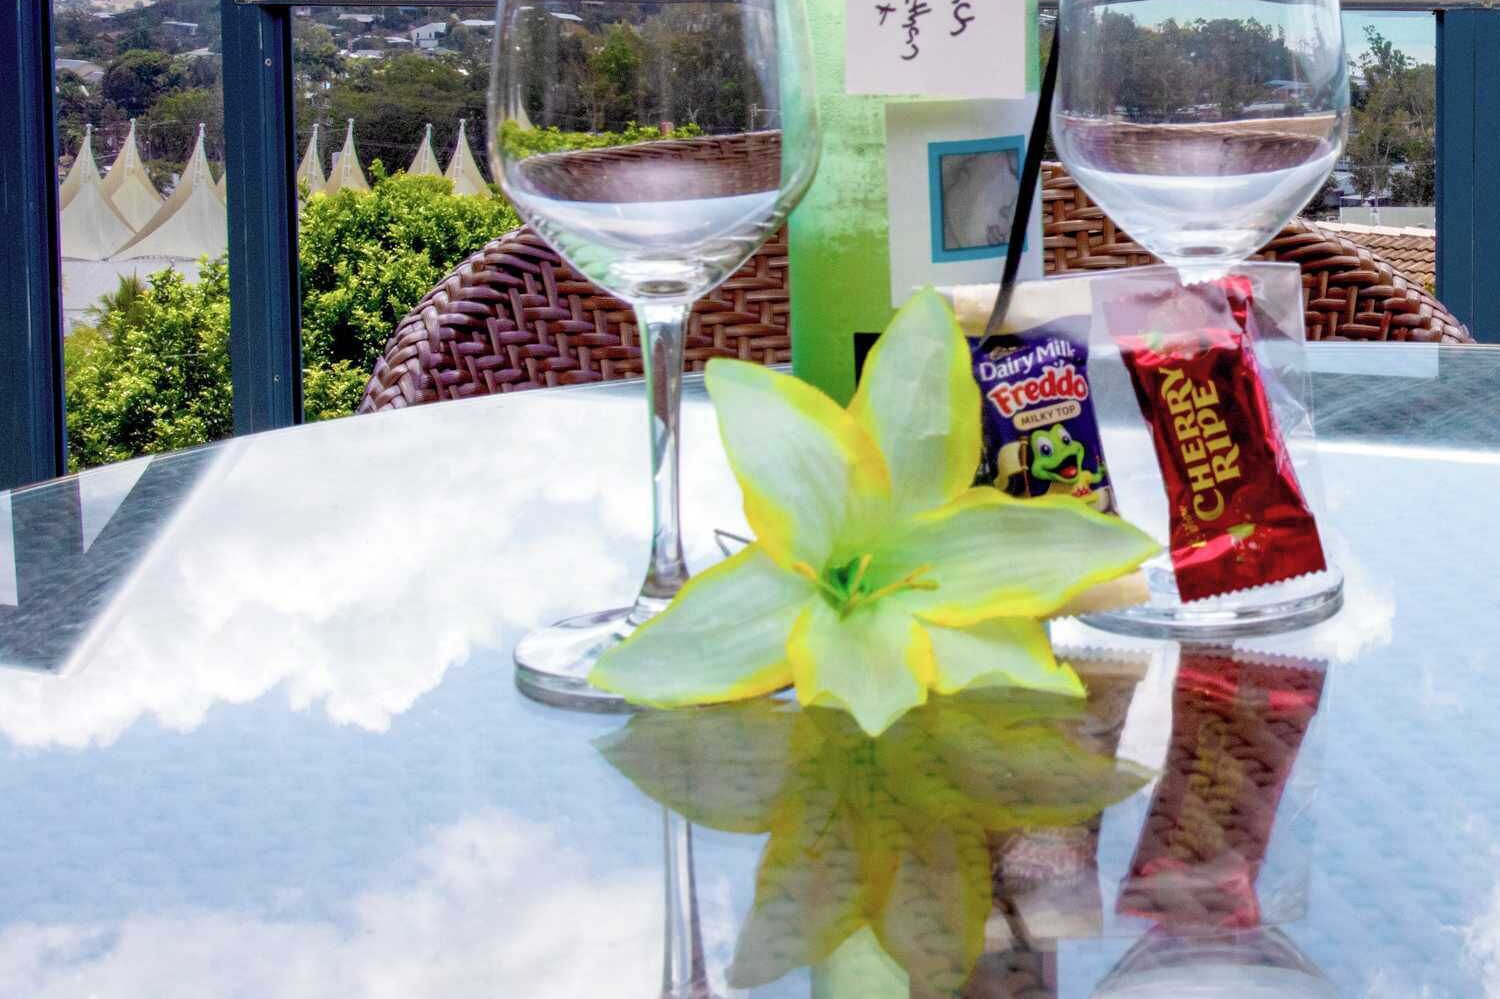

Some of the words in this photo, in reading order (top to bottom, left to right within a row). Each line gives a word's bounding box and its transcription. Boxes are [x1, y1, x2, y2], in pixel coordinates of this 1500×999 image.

[979, 351, 1034, 382] Dairy
[1035, 337, 1077, 363] Milk
[987, 363, 1089, 418] Freddo
[1020, 410, 1055, 426] MILKY
[1055, 404, 1077, 417] TOP
[1158, 366, 1226, 522] CHERRY
[1191, 378, 1242, 484] RIPE
